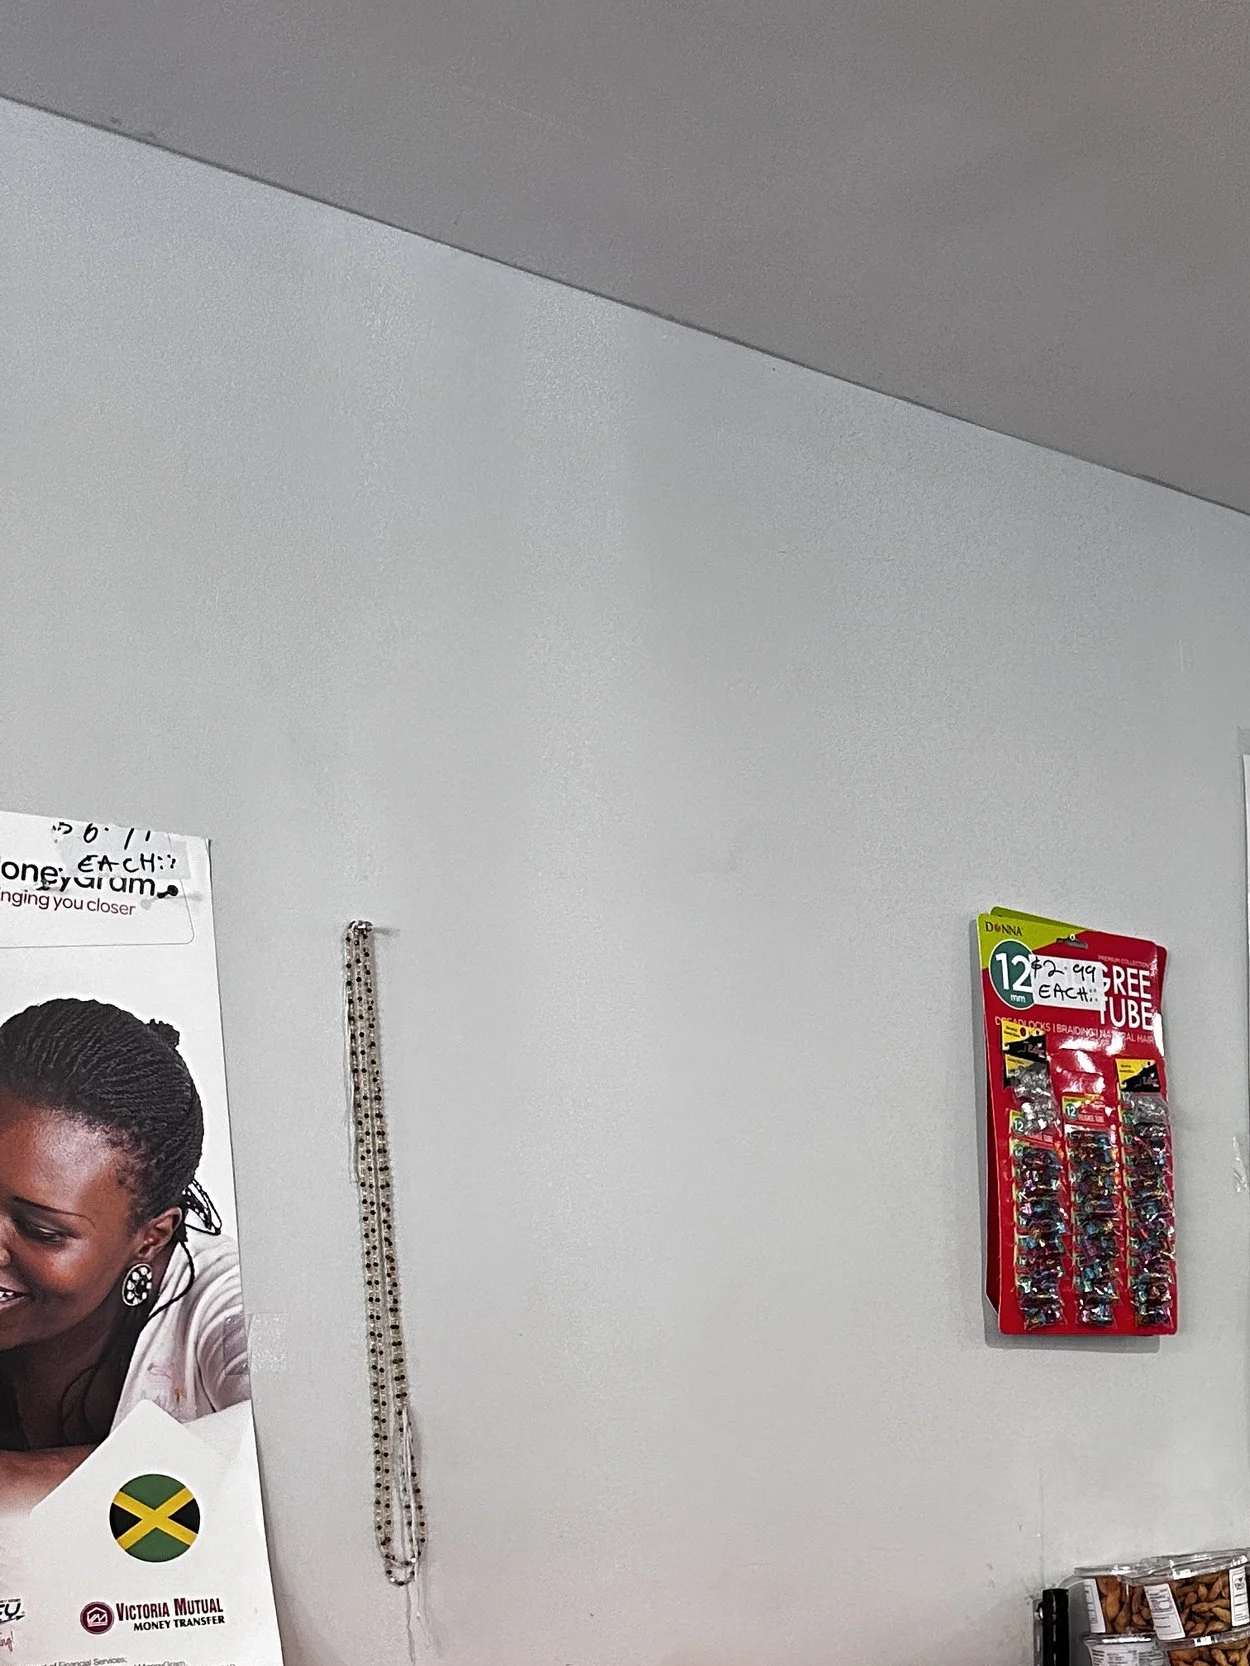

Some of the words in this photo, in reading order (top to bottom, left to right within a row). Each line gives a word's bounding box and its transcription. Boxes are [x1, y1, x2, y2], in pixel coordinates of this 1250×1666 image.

[53, 896, 92, 911] you
[94, 898, 137, 915] closer
[995, 952, 1034, 994] 12
[1031, 957, 1097, 983] $2.99
[1010, 994, 1026, 1003] mm
[1065, 1103, 1077, 1118] 12
[116, 1602, 170, 1622] VICTORIA
[174, 1598, 223, 1617] MUTUAL
[133, 1619, 171, 1631] MONEY
[174, 1615, 225, 1629] TRANSFER
